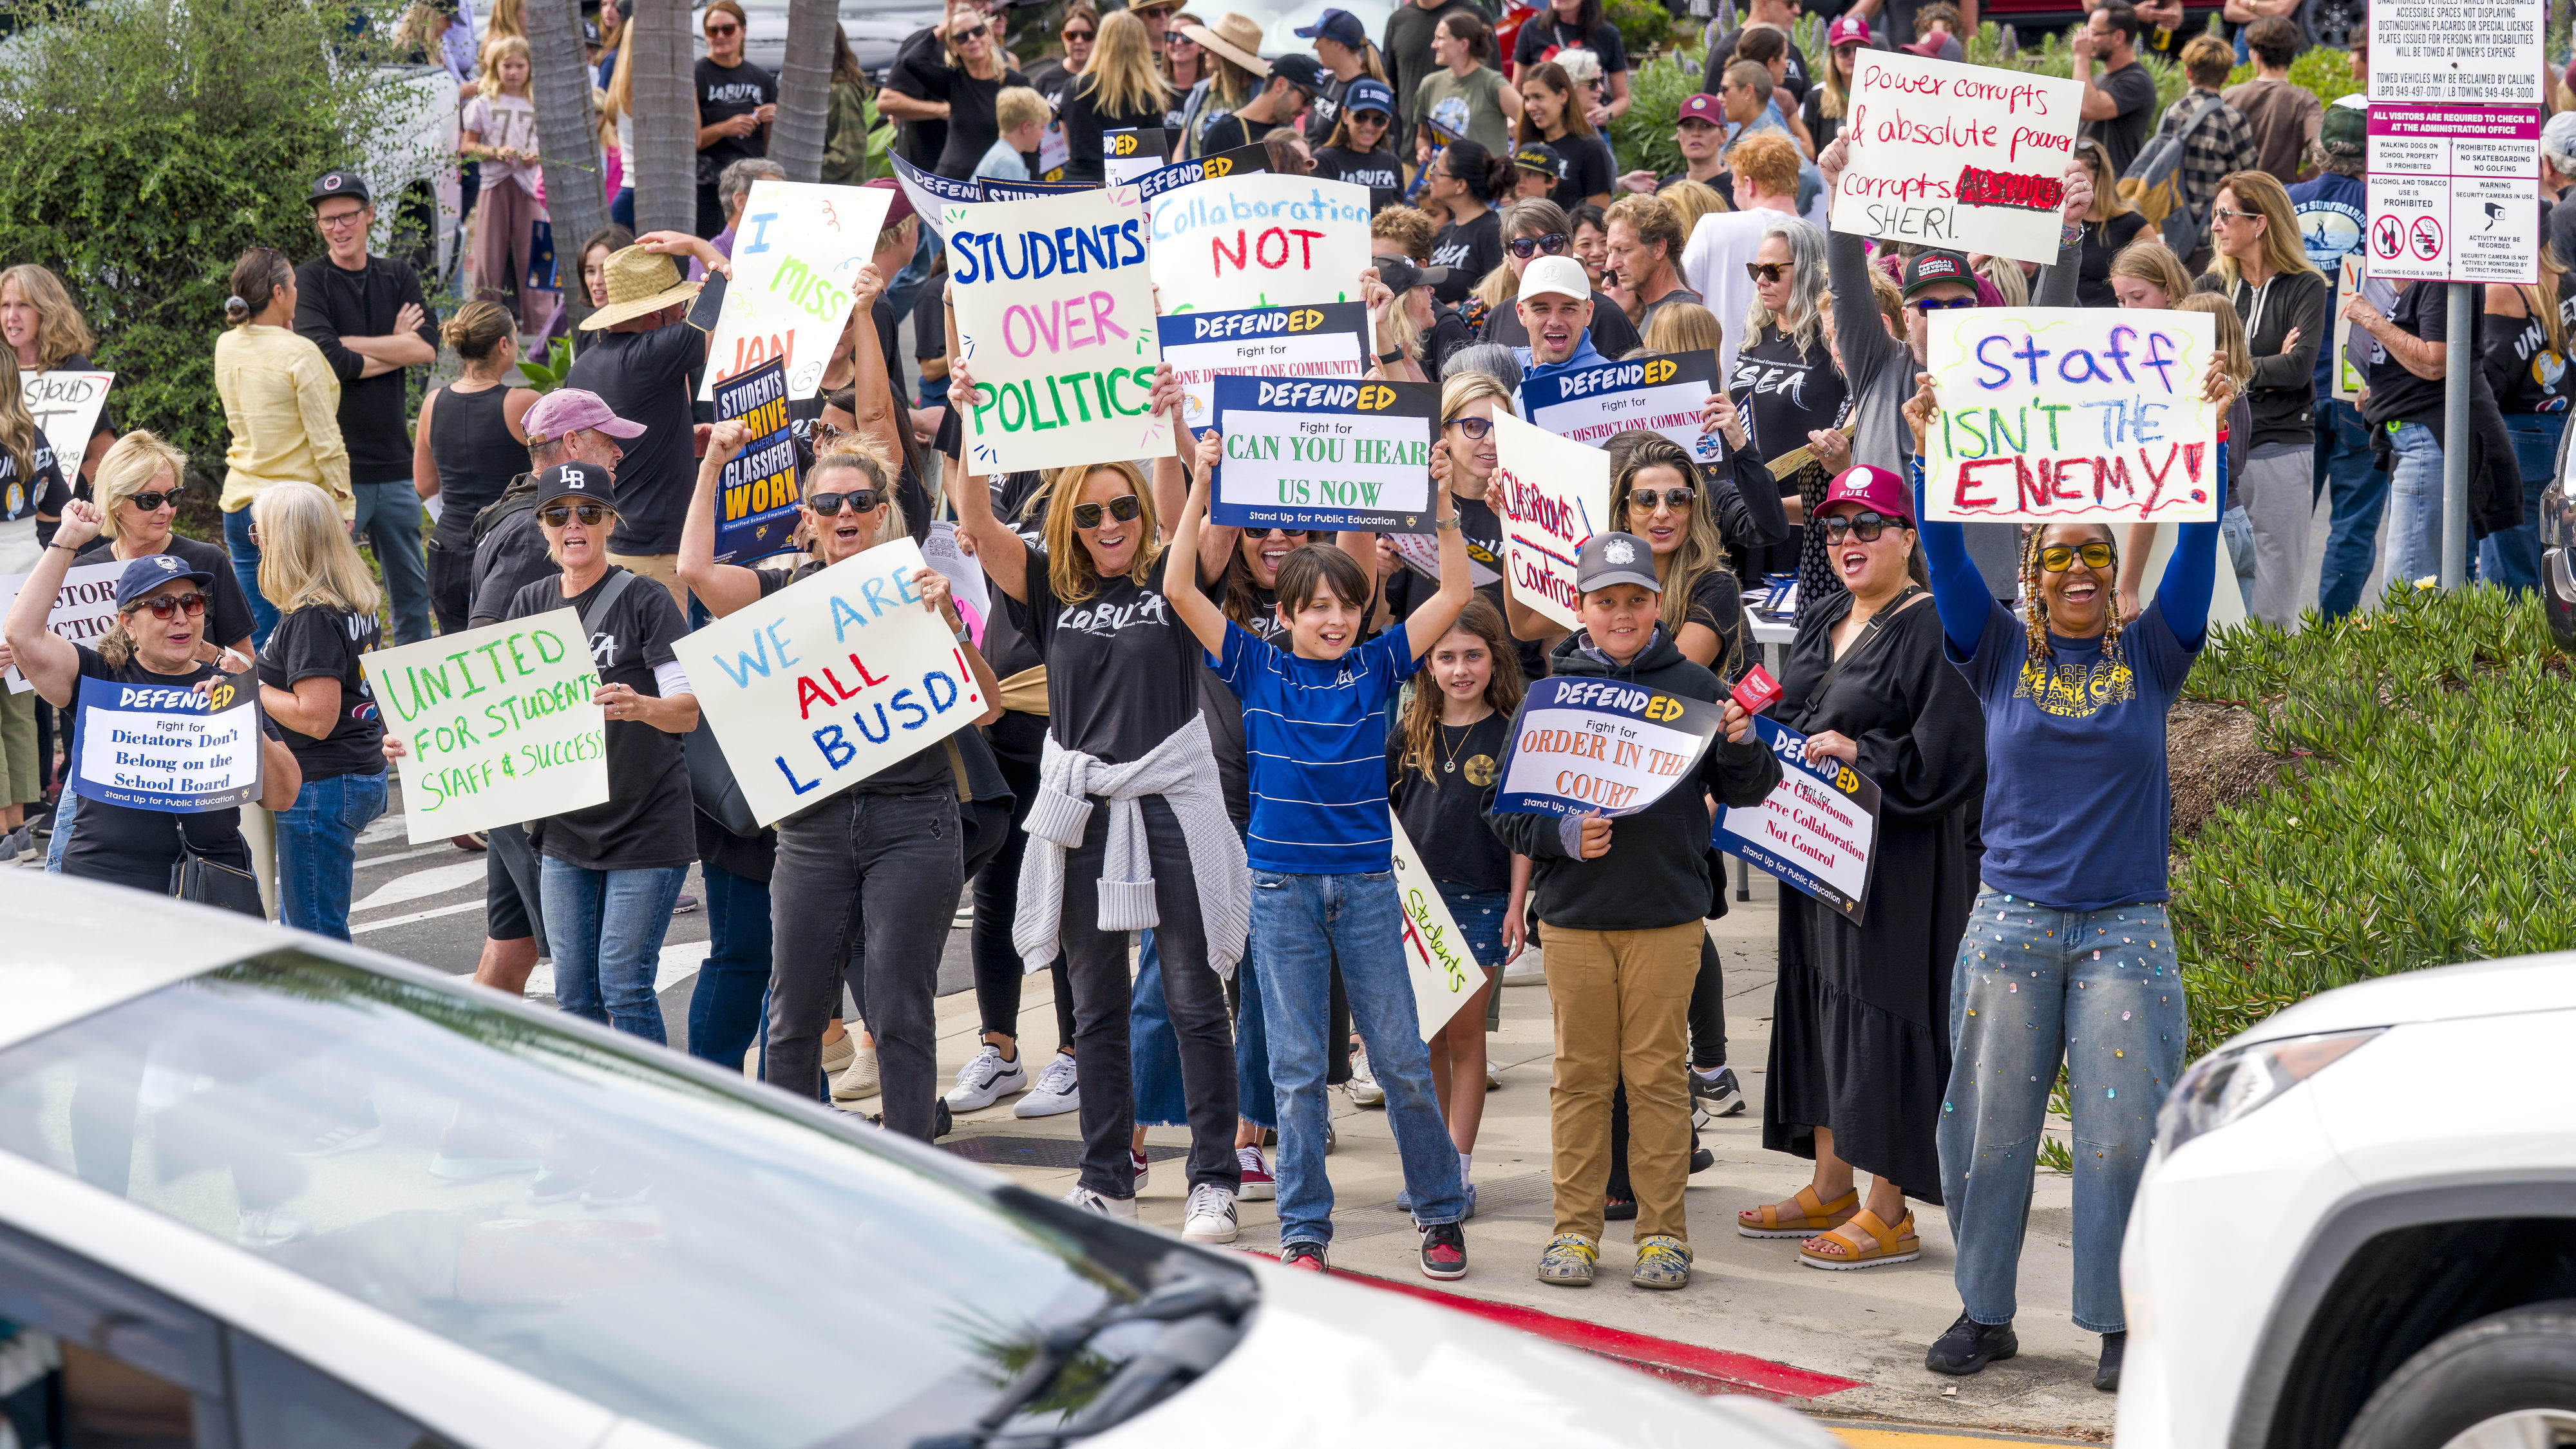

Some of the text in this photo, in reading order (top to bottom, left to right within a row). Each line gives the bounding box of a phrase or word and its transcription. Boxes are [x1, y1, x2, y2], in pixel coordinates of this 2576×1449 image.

[2379, 21, 2533, 31] DISTINGUISHING PLACARDS OR SPECIAL LICENSE
[1954, 79, 2048, 115] corrupts
[2377, 73, 2535, 84] TOWED VEHICLES MAY BE RECLAIMED BY CALLING
[2378, 86, 2394, 96] LBPD
[2396, 86, 2440, 97] 949-497-0701
[2448, 87, 2456, 97] LB
[2458, 87, 2483, 97] TOWING
[2485, 88, 2533, 98] 949-494-3000
[492, 109, 535, 149] 77
[1878, 108, 1997, 147] absolute
[2010, 126, 2073, 163] power
[2373, 111, 2387, 120] ALL
[2389, 112, 2425, 121] VISITORS
[2426, 113, 2441, 121] ARE
[2443, 113, 2483, 122] REQUIRED
[2497, 115, 2524, 123] CHECK
[1140, 157, 1232, 197] EFENDED
[1843, 173, 1951, 202] corrupts
[1151, 188, 1370, 242] Collaboration
[2384, 199, 2433, 207] PROHIBITED
[743, 213, 778, 254] I
[951, 218, 1145, 284] STUDENTS
[1212, 227, 1326, 278] NOT
[1919, 260, 1947, 269] FORMULA
[768, 254, 848, 322] MISS
[1002, 290, 1130, 357] OVER
[1195, 308, 1324, 339] DEFENDED
[715, 328, 795, 382] JAN
[1237, 345, 1286, 357] Fight for
[1974, 324, 2178, 394] Staff
[1175, 360, 1359, 385] ONE DISTRICT ONE COMMUNITY
[1559, 359, 1677, 398] DEFENDED
[24, 378, 93, 406] SHOULD
[721, 370, 783, 419] STUDENTS
[971, 366, 1158, 436] POLITICS
[1258, 381, 1397, 410] DEFENDED
[1602, 398, 1646, 412] Fight for
[728, 395, 788, 442] RIVE
[1300, 422, 1352, 434] Fight for
[1573, 421, 1624, 442] DISTRICT
[1626, 418, 1648, 432] ONE
[1651, 410, 1710, 430] COMMUNI
[1940, 394, 2169, 460] ISN'T THE
[748, 436, 774, 453] WHERE
[1227, 434, 1428, 466] CAN YOU HEAR
[560, 466, 584, 489] LB
[725, 440, 793, 488] CLASSIFIED
[1953, 442, 2207, 520] ENEMY!
[725, 466, 799, 521] WORK
[1278, 478, 1383, 507] US NOW
[1839, 489, 1870, 498] FUEL
[724, 509, 790, 530] Classified School Employee
[712, 565, 922, 689] WE ARE
[381, 630, 565, 722] UNITED
[797, 652, 889, 720] ALL
[120, 685, 234, 711] DEFENDED
[1554, 681, 1683, 722] DEFENDED
[156, 721, 205, 732] Fight for
[413, 673, 601, 762] FOR STUDENTS
[1587, 720, 1637, 739] Fight for
[111, 728, 238, 748] Dictators Don't
[1522, 730, 1691, 776] ORDER IN THE
[115, 752, 232, 773] Belong on the
[420, 759, 493, 812] STAFF
[521, 729, 604, 777] SUCCESS
[104, 791, 129, 801] Stand
[134, 795, 146, 804] Up
[149, 797, 162, 805] for
[194, 795, 234, 806] Education
[115, 773, 230, 791] School Board
[1556, 770, 1638, 807] COURT
[1797, 779, 1830, 804] Fight for
[1794, 784, 1853, 828] Classrooms
[1765, 819, 1835, 869] Not Control
[1793, 808, 1865, 863] Collaboration
[1404, 889, 1465, 993] Students
